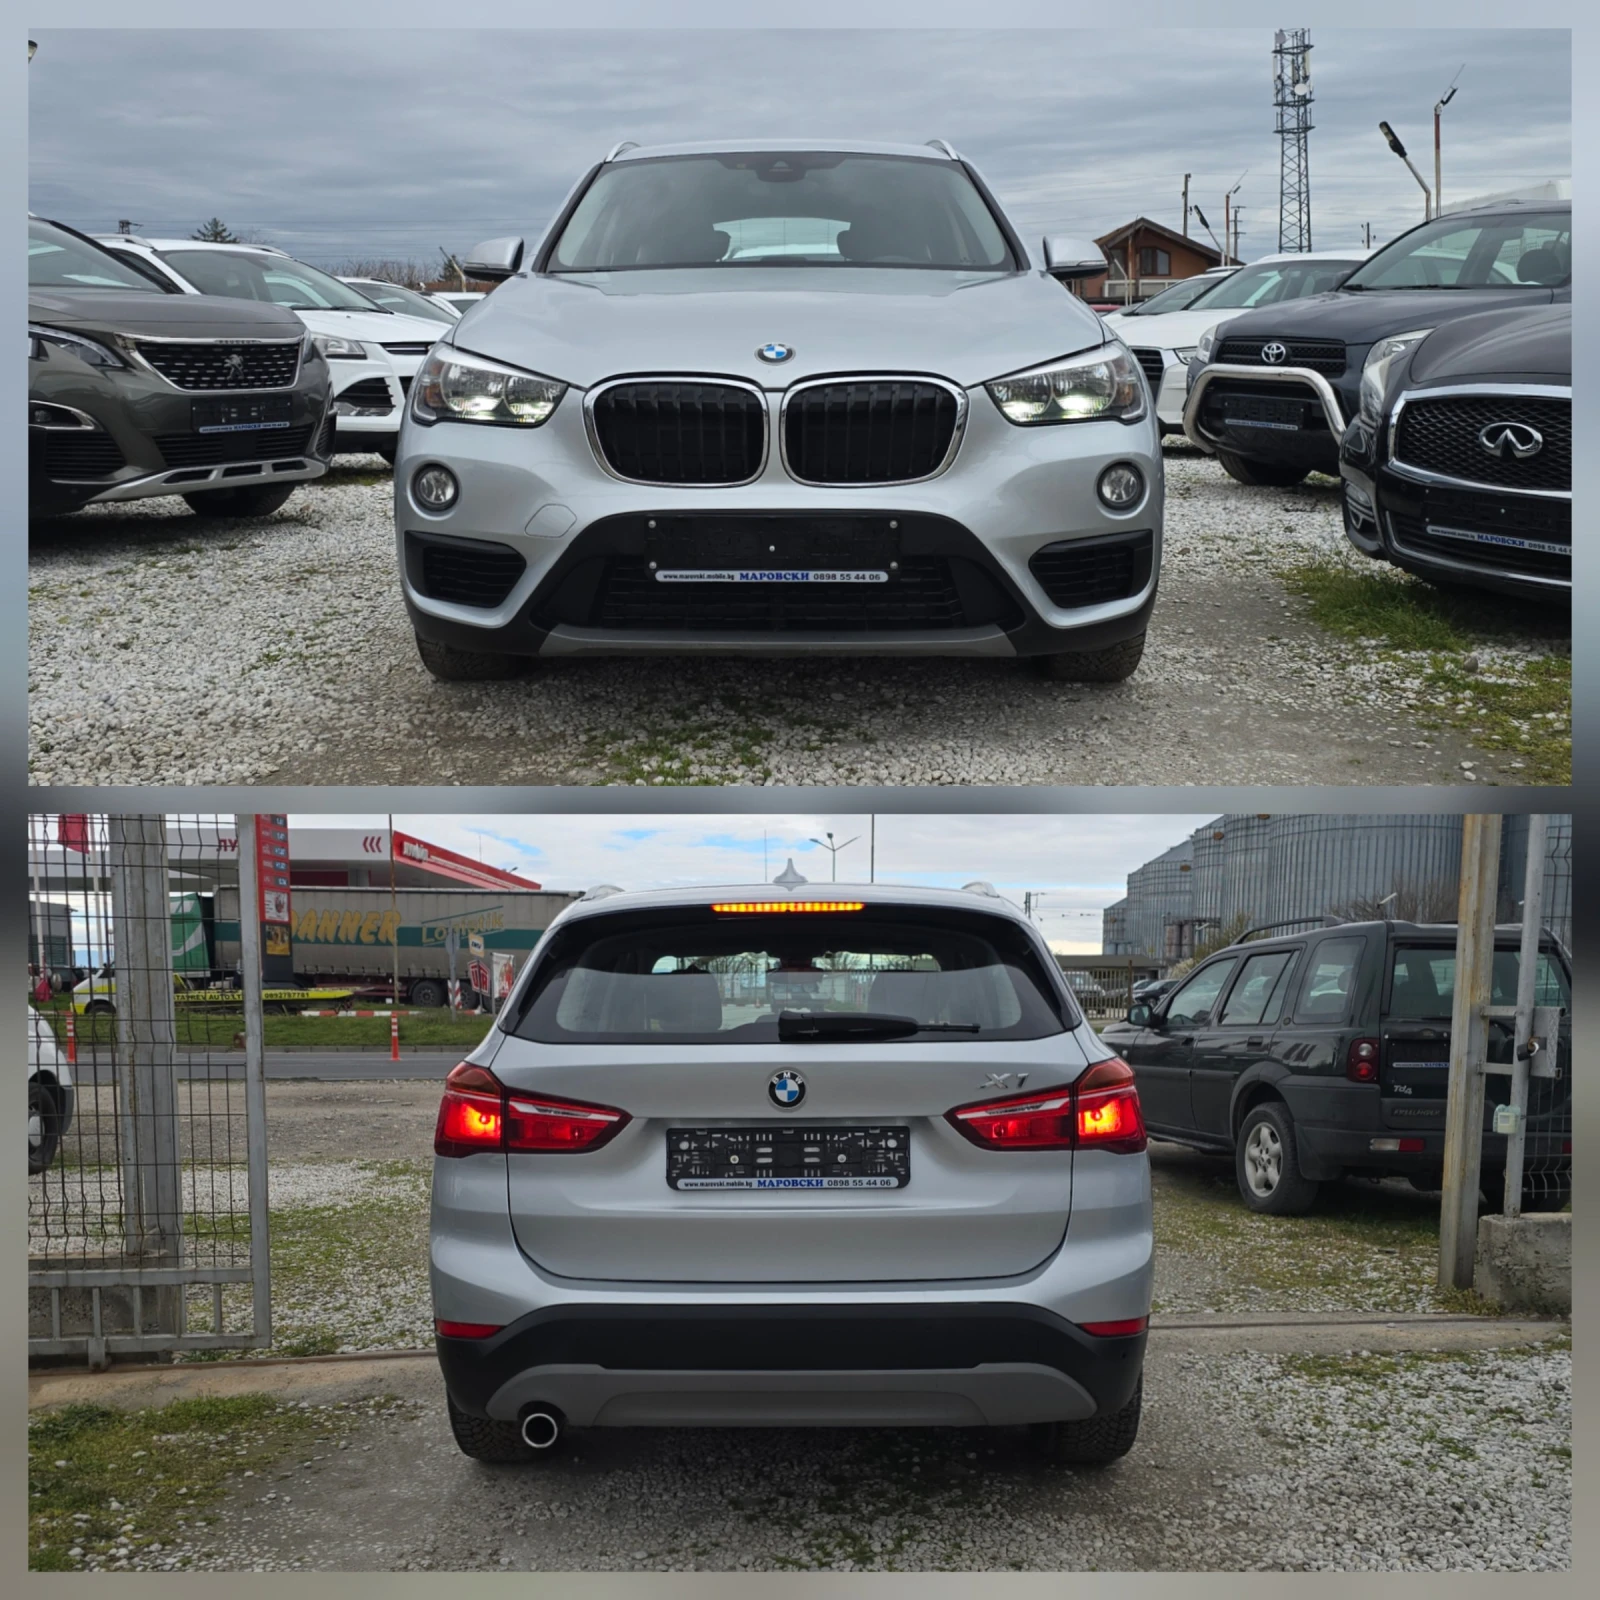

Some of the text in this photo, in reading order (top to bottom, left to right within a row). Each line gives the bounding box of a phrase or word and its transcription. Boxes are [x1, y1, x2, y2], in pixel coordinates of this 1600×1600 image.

[739, 572, 809, 581] МАРОВСКИ
[813, 573, 837, 581] 0898
[839, 573, 852, 581] 55
[854, 573, 867, 581] 44
[868, 573, 881, 581] 06
[979, 1072, 1030, 1089] X1
[1393, 1085, 1413, 1095] Td4
[757, 1179, 824, 1188] МАРОВСКИ
[827, 1179, 850, 1187] 0898
[852, 1179, 864, 1187] 55
[866, 1179, 878, 1187] 44
[880, 1179, 891, 1187] 06
